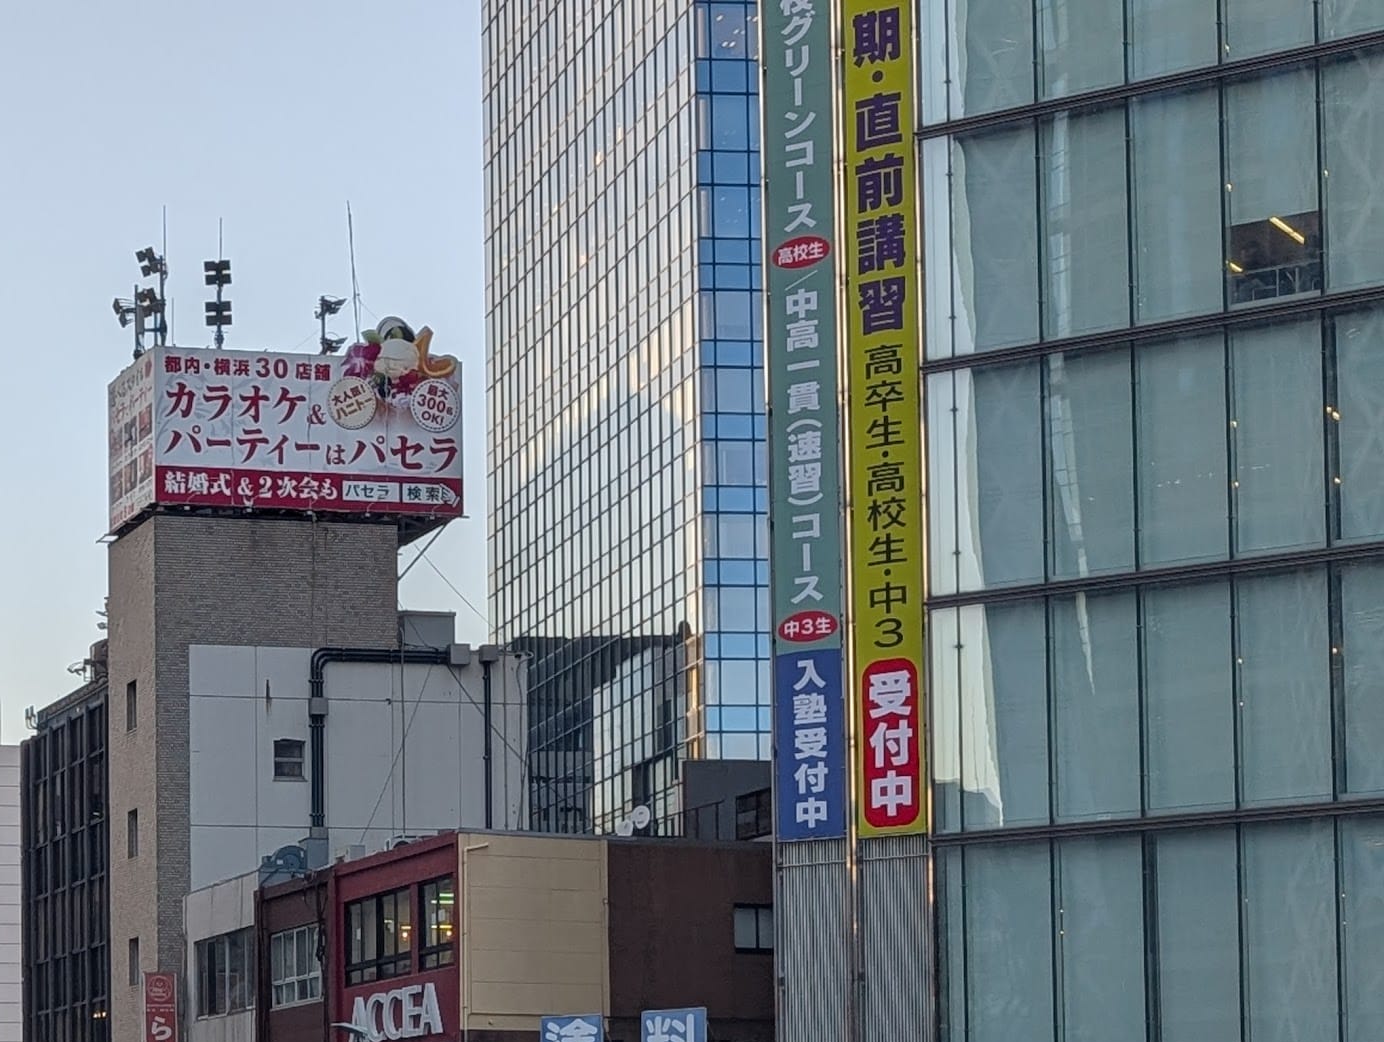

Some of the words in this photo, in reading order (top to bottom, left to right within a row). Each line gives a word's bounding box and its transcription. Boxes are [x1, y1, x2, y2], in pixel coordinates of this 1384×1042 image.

[853, 7, 906, 336] 期・直前講習
[777, 242, 825, 265] 高校生
[335, 397, 373, 420] ハニトー
[421, 411, 444, 425] OK!
[163, 425, 458, 473] パーティーはパセラ
[345, 485, 390, 499] パセラ
[407, 486, 441, 502] 検索
[864, 344, 907, 648] 高卒生・高校生・中3
[784, 617, 832, 638] 中3生
[793, 659, 828, 828] 入塾受付中
[869, 670, 912, 817] 受付中
